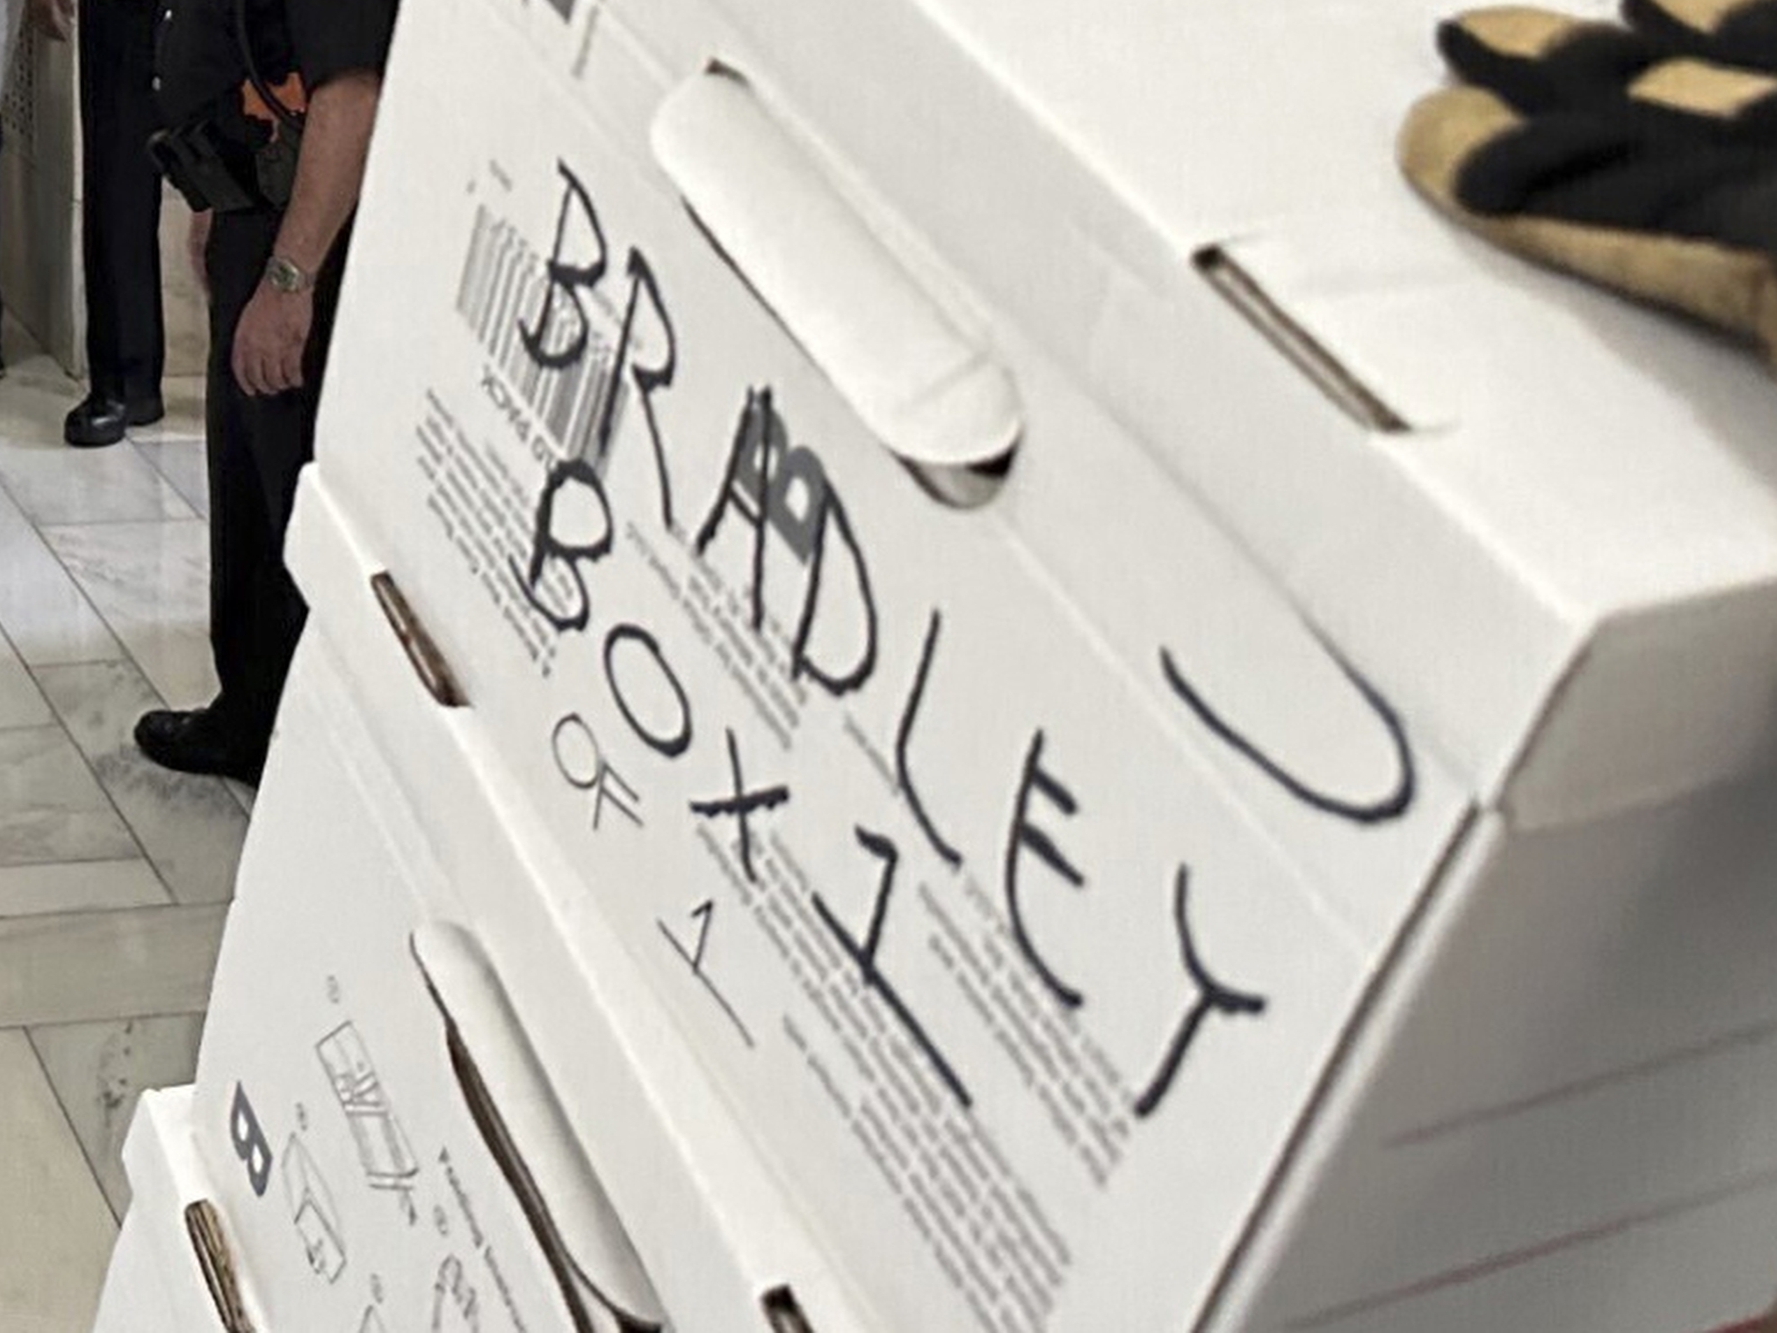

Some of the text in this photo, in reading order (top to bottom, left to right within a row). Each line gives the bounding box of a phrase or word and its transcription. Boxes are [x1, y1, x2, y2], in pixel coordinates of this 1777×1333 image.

[507, 459, 790, 883] BOX
[518, 157, 1267, 1119] BRADLEY
[552, 712, 644, 830] OF
[229, 1080, 272, 1197] B
